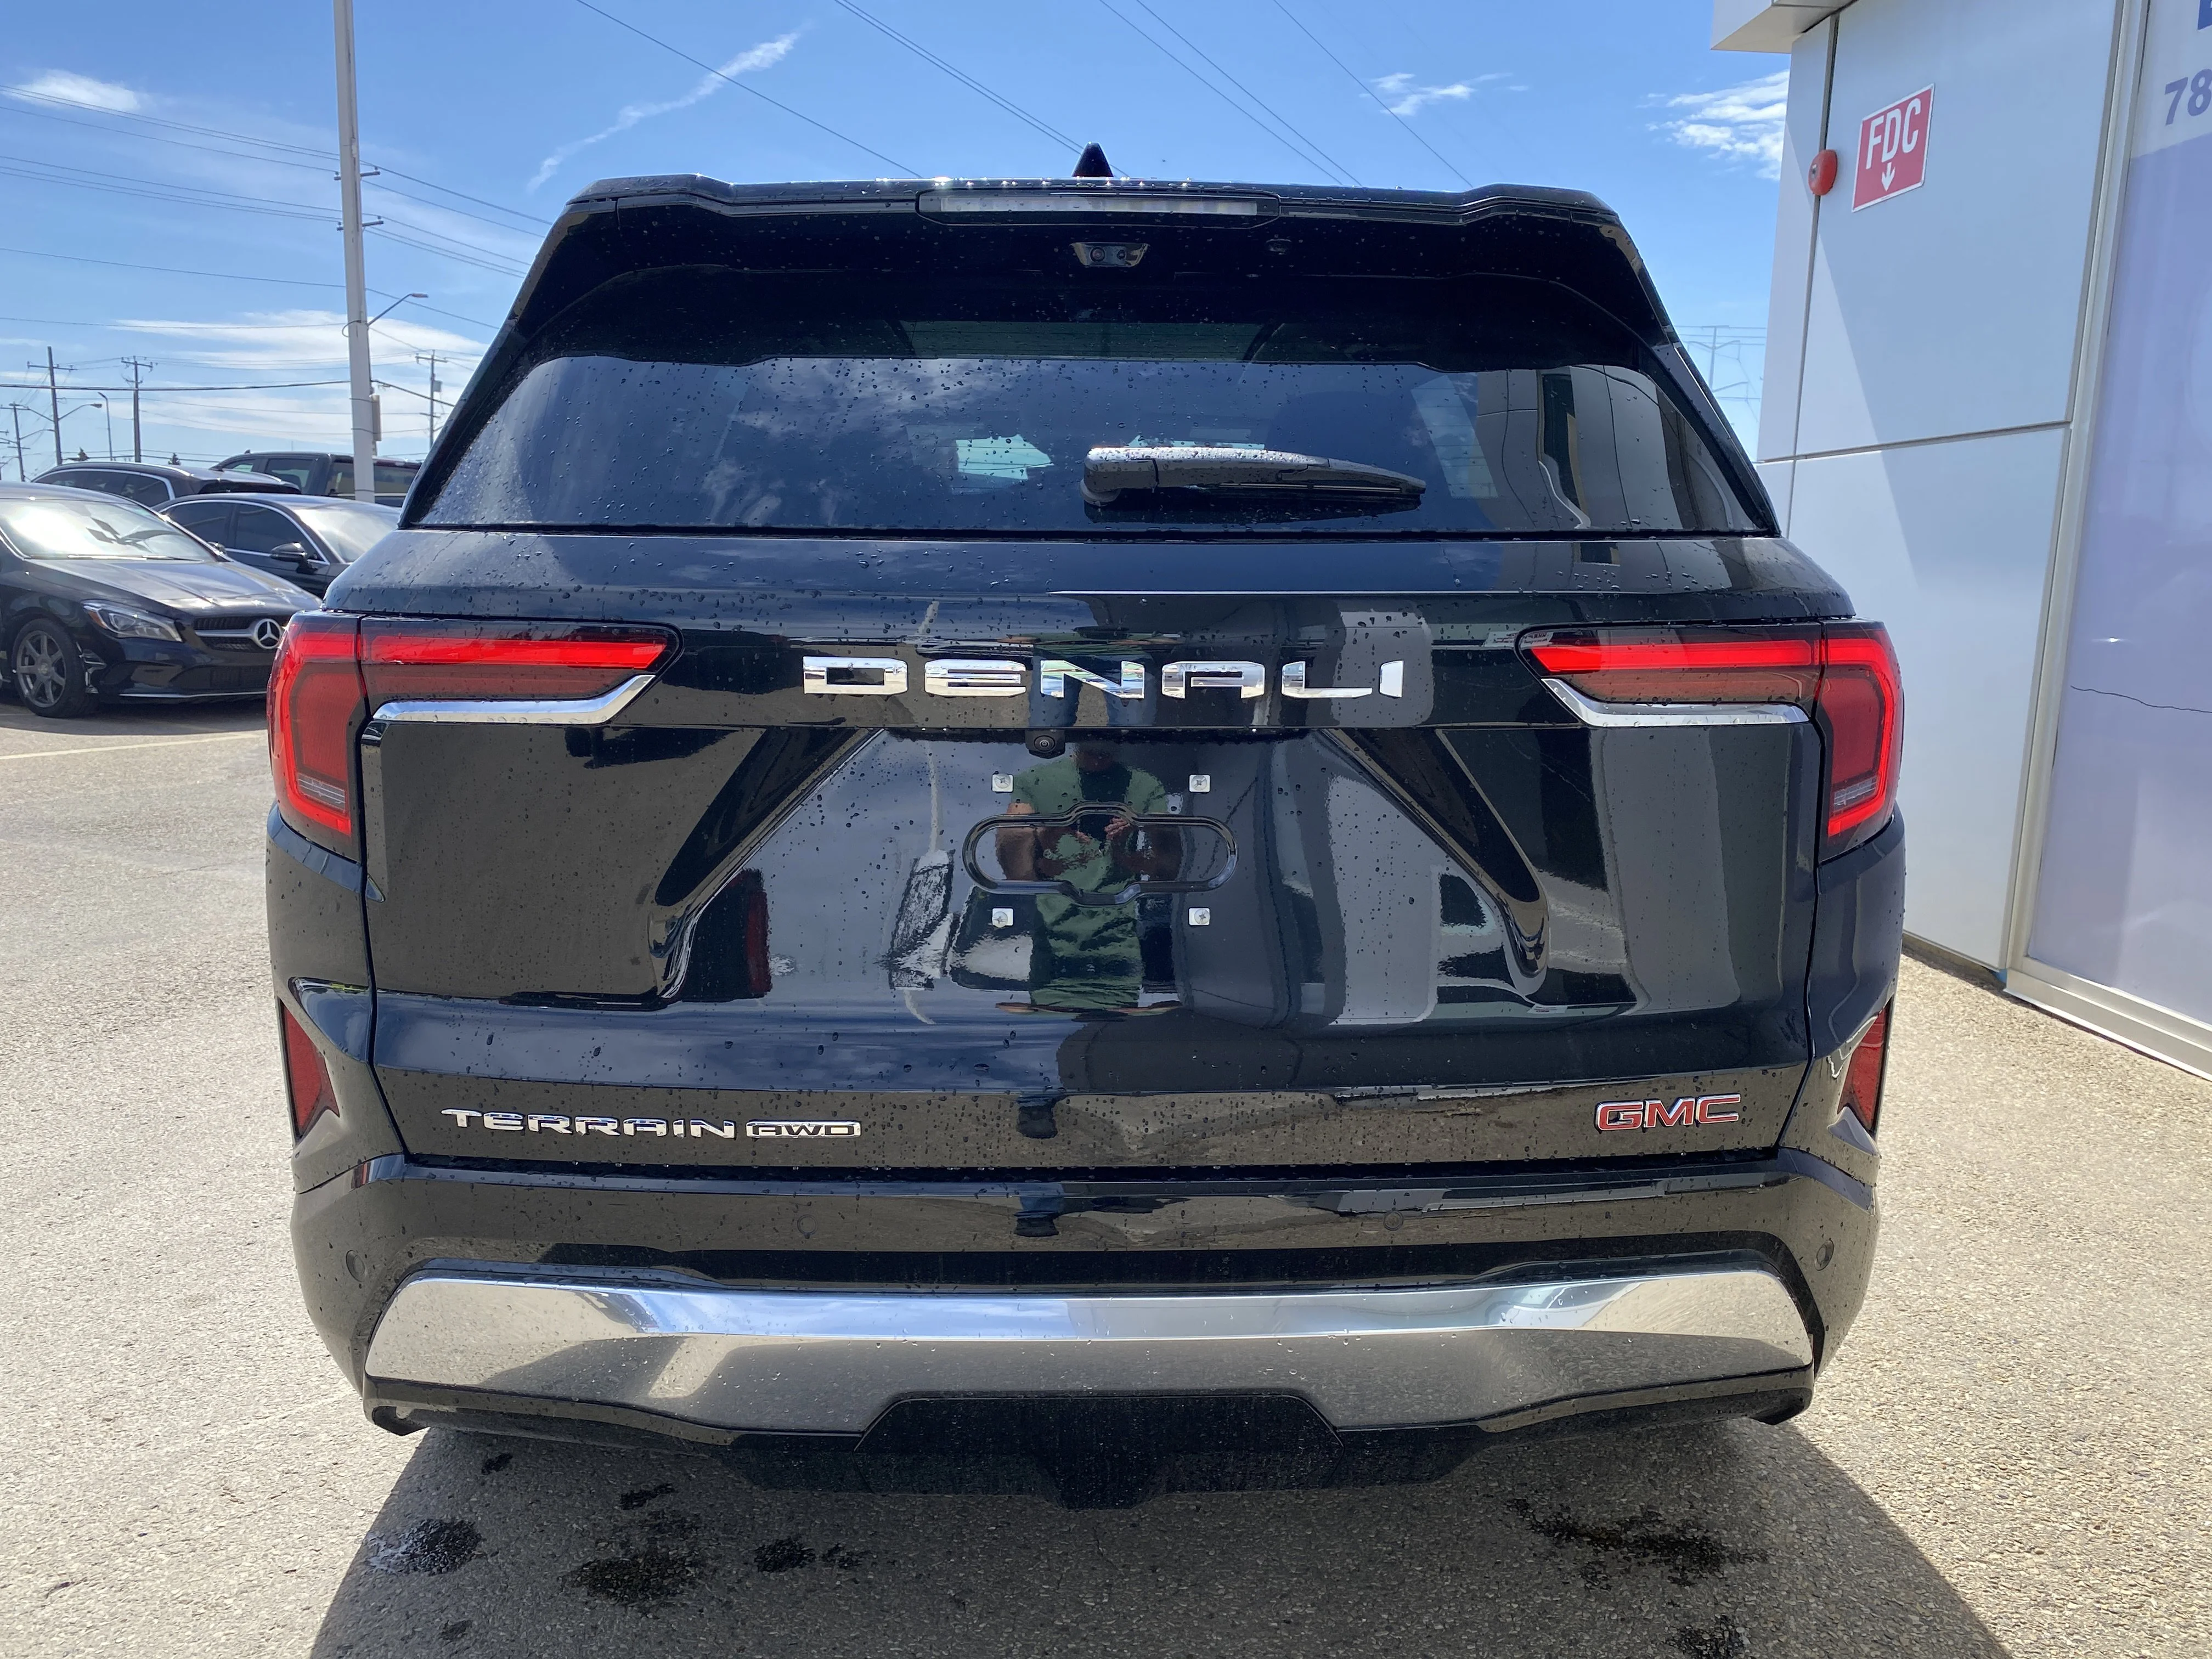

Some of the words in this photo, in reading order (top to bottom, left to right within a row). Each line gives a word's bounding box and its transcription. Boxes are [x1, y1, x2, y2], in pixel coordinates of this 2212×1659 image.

[1865, 98, 1921, 170] FDC
[803, 656, 1404, 698] DENALI
[441, 1108, 736, 1138] TERRAIN
[746, 1120, 861, 1138] AWD
[1595, 1094, 1741, 1131] GMC
